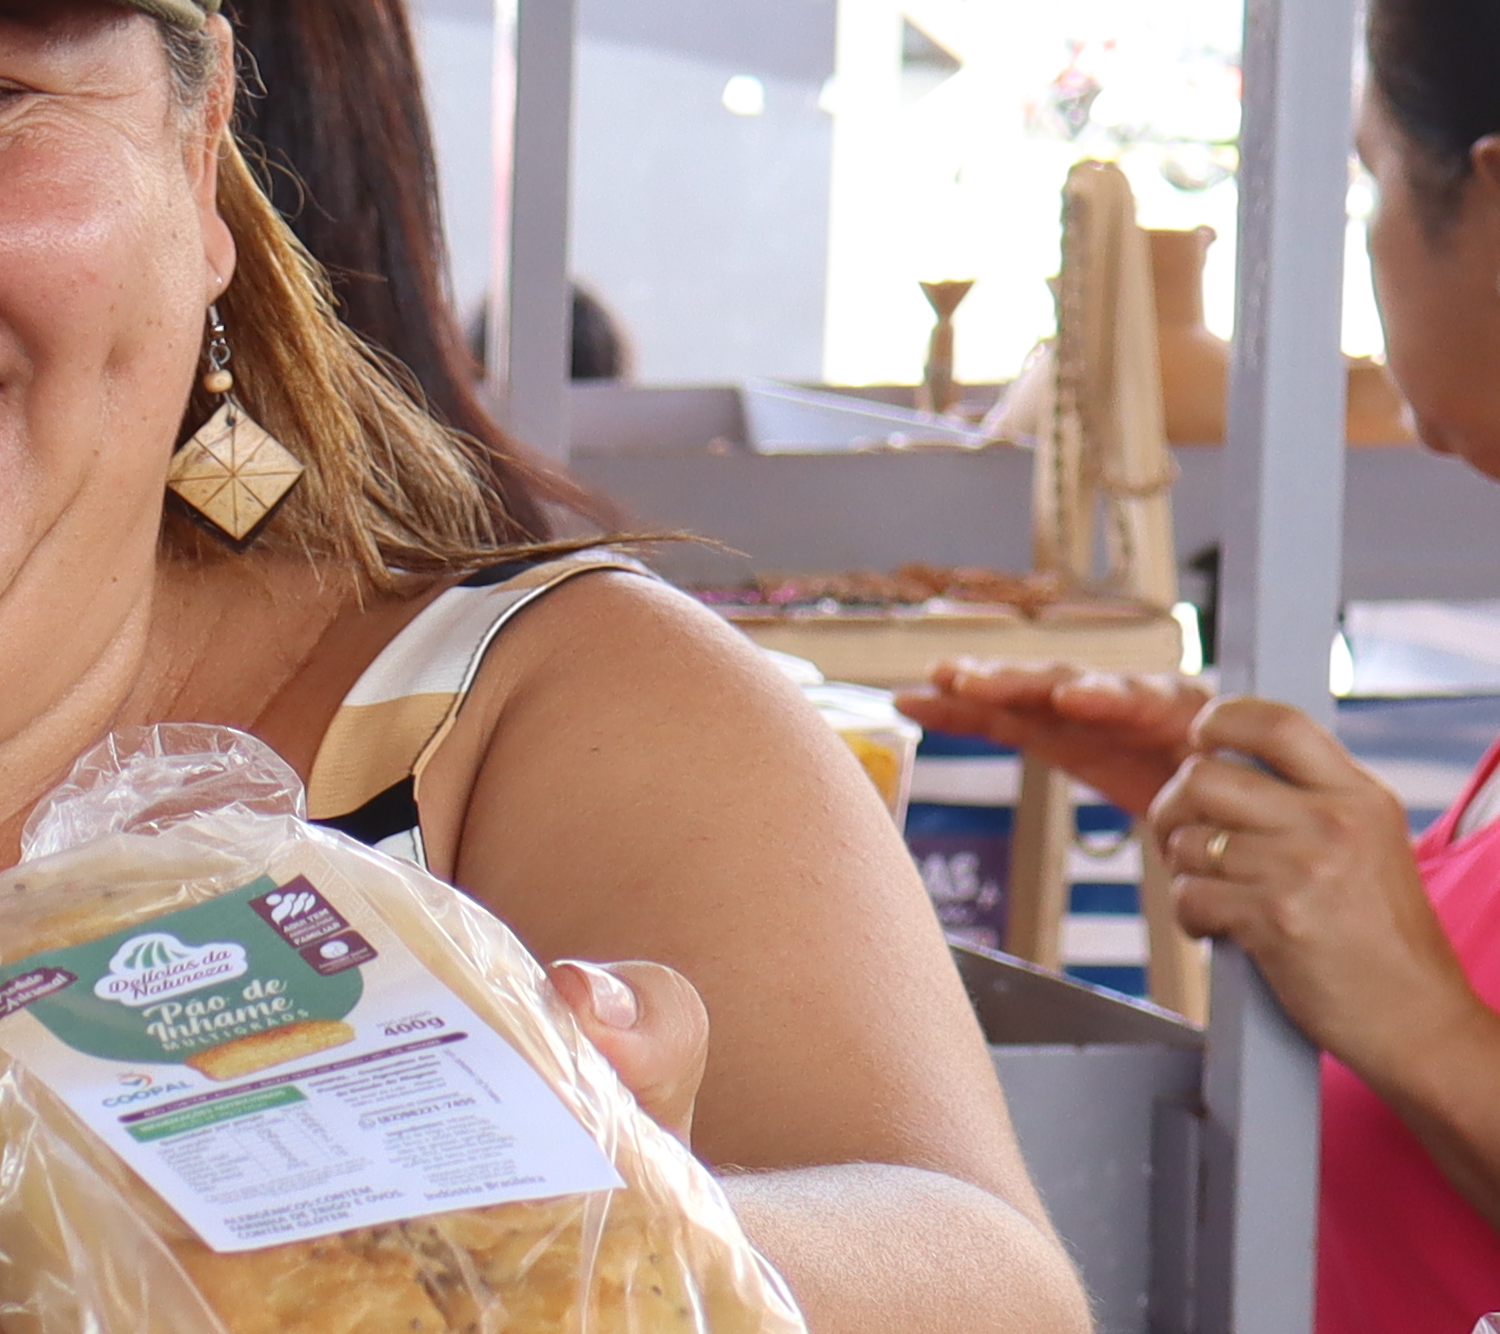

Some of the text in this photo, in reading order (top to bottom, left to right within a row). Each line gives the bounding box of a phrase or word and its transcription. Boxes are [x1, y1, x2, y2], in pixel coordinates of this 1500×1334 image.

[108, 949, 232, 994] Delícias da
[132, 961, 234, 1000] Natureza
[142, 978, 288, 1025] Pão de
[146, 997, 294, 1043] Inhame
[383, 1014, 446, 1038] 400g
[102, 1078, 193, 1109] COOPAL
